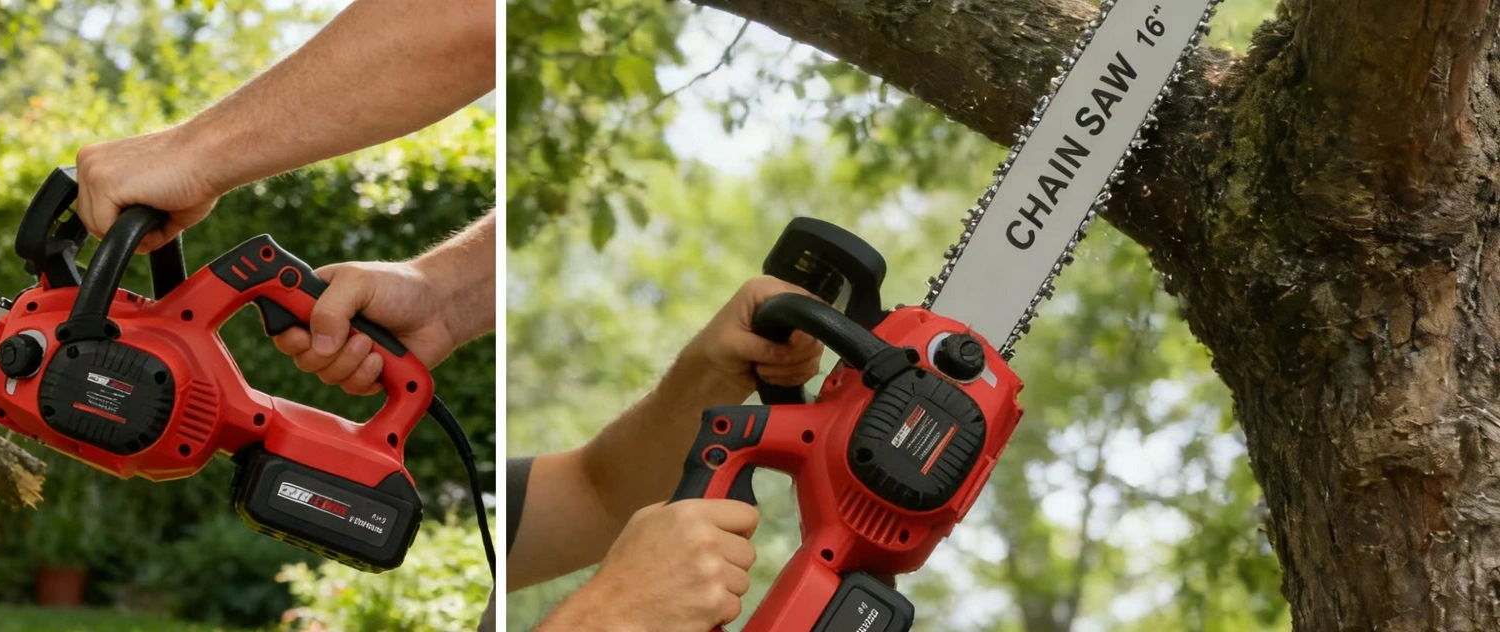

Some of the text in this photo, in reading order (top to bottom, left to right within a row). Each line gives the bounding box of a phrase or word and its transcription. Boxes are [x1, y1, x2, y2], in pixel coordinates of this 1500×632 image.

[1006, 4, 1165, 250] CHAIN SAW 16"
